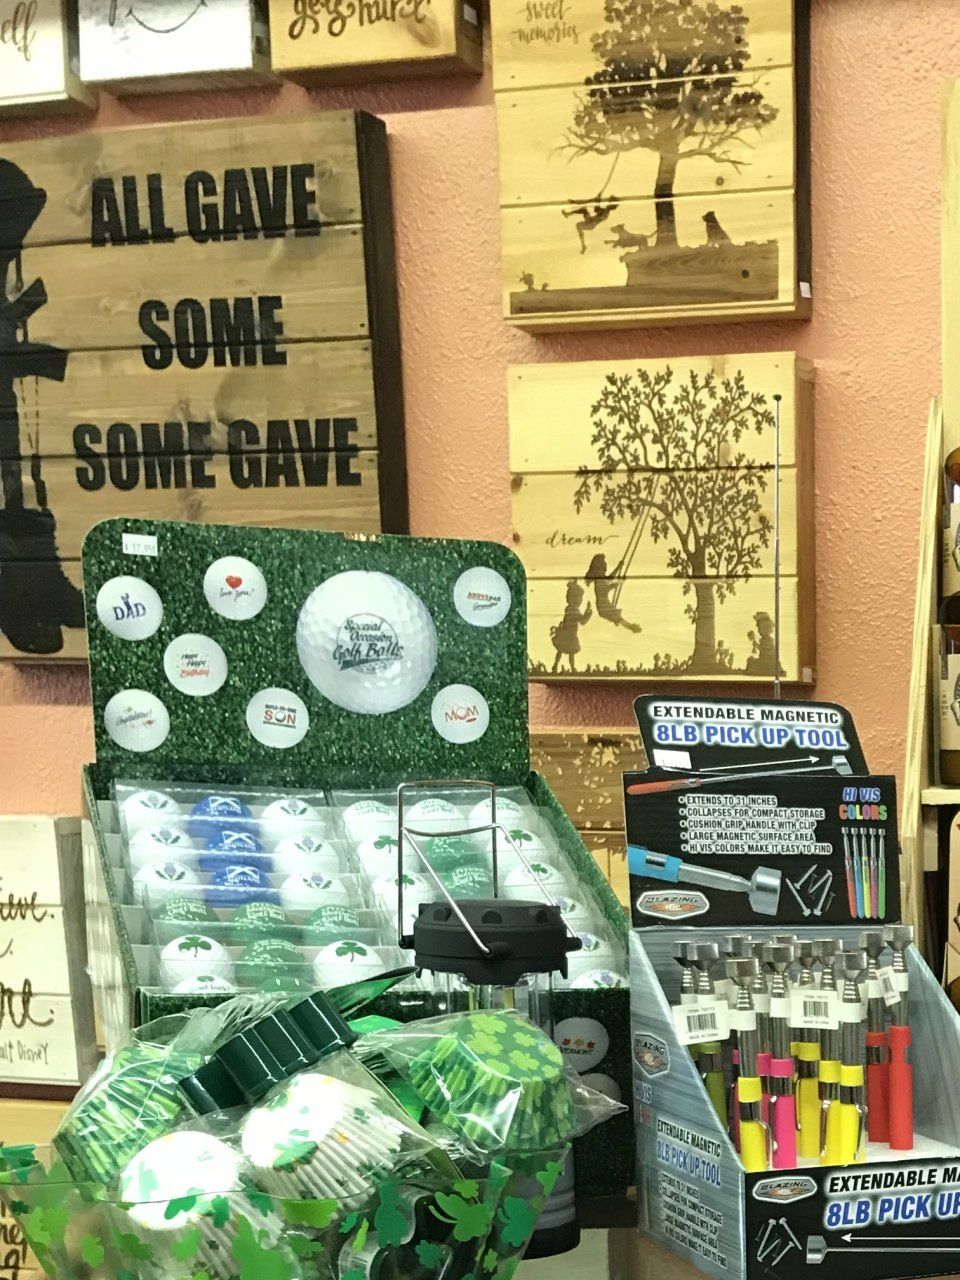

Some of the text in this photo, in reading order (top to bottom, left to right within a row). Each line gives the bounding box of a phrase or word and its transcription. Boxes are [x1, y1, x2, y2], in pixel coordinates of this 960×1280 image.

[91, 163, 321, 248] ALL GAVE
[138, 295, 288, 371] SOME
[72, 417, 362, 491] SOME GAVE
[546, 530, 619, 548] dream
[113, 594, 147, 621] DAD
[344, 619, 382, 632] Special
[349, 631, 393, 643] Occasion
[333, 645, 363, 665] Golf
[444, 705, 479, 723] MOM
[653, 705, 839, 724] EXTENDABLE MAGNETIC
[656, 724, 847, 748] 8LB PICK UP TOOL
[686, 796, 777, 806] EXTENDS TO 31 INCHES
[843, 787, 881, 802] HI VIS
[687, 808, 824, 819] COLLAPSES FOR COMPACT STORAGE
[839, 804, 888, 821] COLORS
[688, 820, 816, 830] CUSHION GRIP HANDLE WITH CLIP
[688, 832, 815, 842] LARGE MAGNETIC SURFACE AREA
[689, 844, 833, 853] HI VIS COLORS MAKE IT EASY TO FIND
[829, 1170, 938, 1194] EXTENDABLE
[826, 1200, 871, 1228] 8LB
[877, 1194, 931, 1222] PICK
